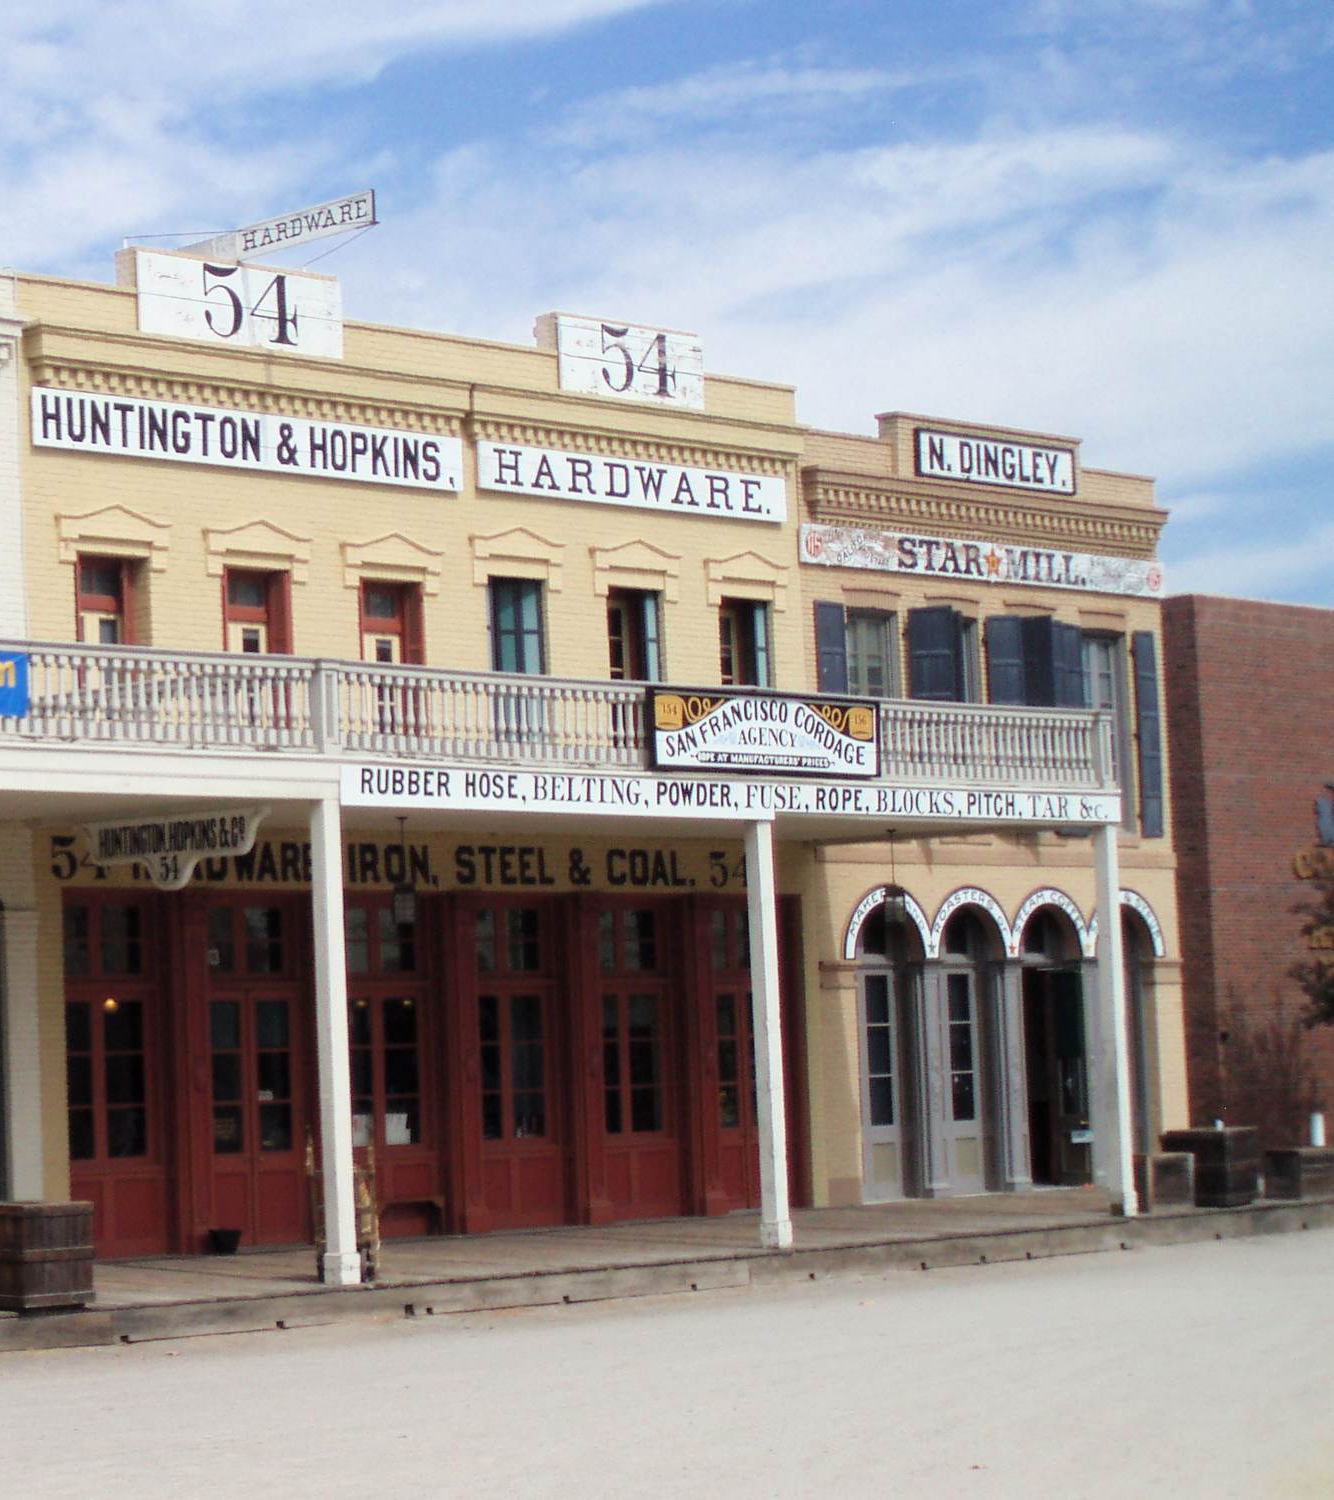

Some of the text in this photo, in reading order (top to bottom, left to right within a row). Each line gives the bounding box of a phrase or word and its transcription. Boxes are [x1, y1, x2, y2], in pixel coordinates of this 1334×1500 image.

[242, 199, 368, 252] HARDWARE
[202, 263, 299, 346] 54
[602, 323, 677, 398] 54
[41, 394, 456, 487] HUNTINGTON & HOPKINS,
[927, 436, 1067, 487] N. DINGLEY.
[493, 448, 771, 514] HARDWARE.
[897, 536, 985, 577] STAR
[1005, 548, 1086, 586] MILL.
[666, 698, 866, 766] SAN FRANCISCO CORDAGE
[738, 726, 797, 748] AGENCY
[360, 768, 452, 799] RUBBER
[465, 772, 526, 805] HOSE,
[533, 775, 649, 808] BELTING,
[656, 781, 739, 811] POWDER,
[745, 784, 810, 813] FUSE,
[815, 787, 870, 814] ROPE,
[876, 789, 962, 818] BLOCKS,
[1028, 795, 1070, 819] TAR
[347, 843, 440, 888] IRON,
[455, 845, 555, 885] STEEL
[569, 847, 591, 886] &
[606, 849, 696, 888] COAL.
[934, 890, 995, 935] ROASTERS
